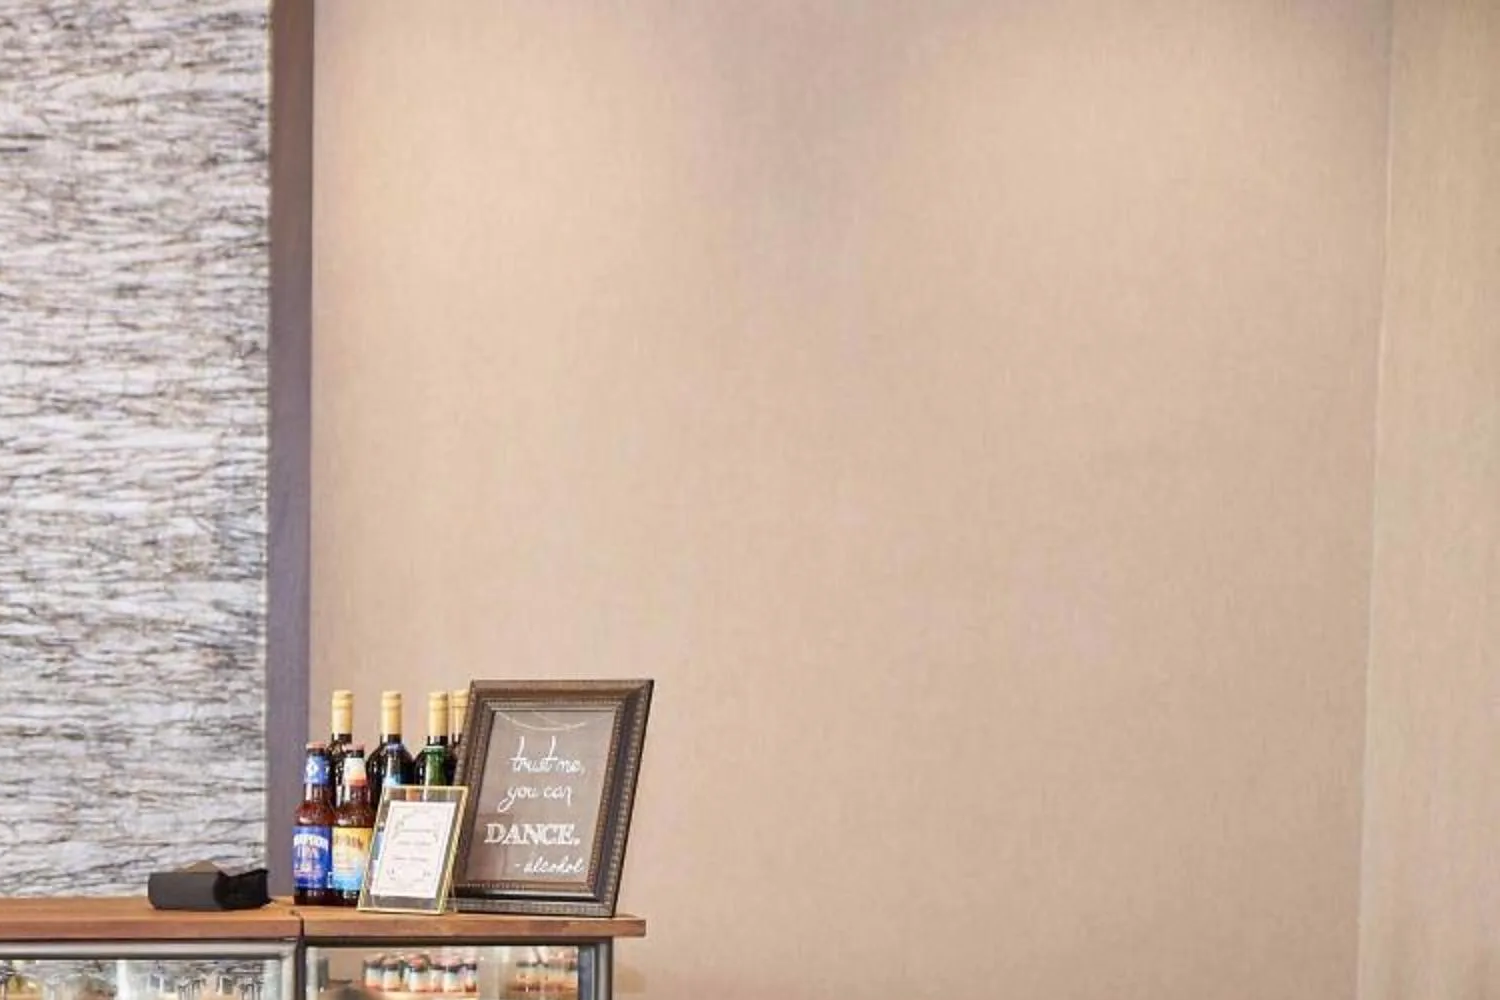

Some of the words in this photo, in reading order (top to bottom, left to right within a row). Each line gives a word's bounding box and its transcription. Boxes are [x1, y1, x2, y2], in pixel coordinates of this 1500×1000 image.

[510, 735, 558, 774] trust
[497, 785, 538, 813] you
[543, 785, 572, 808] can
[484, 823, 581, 845] DANCE.
